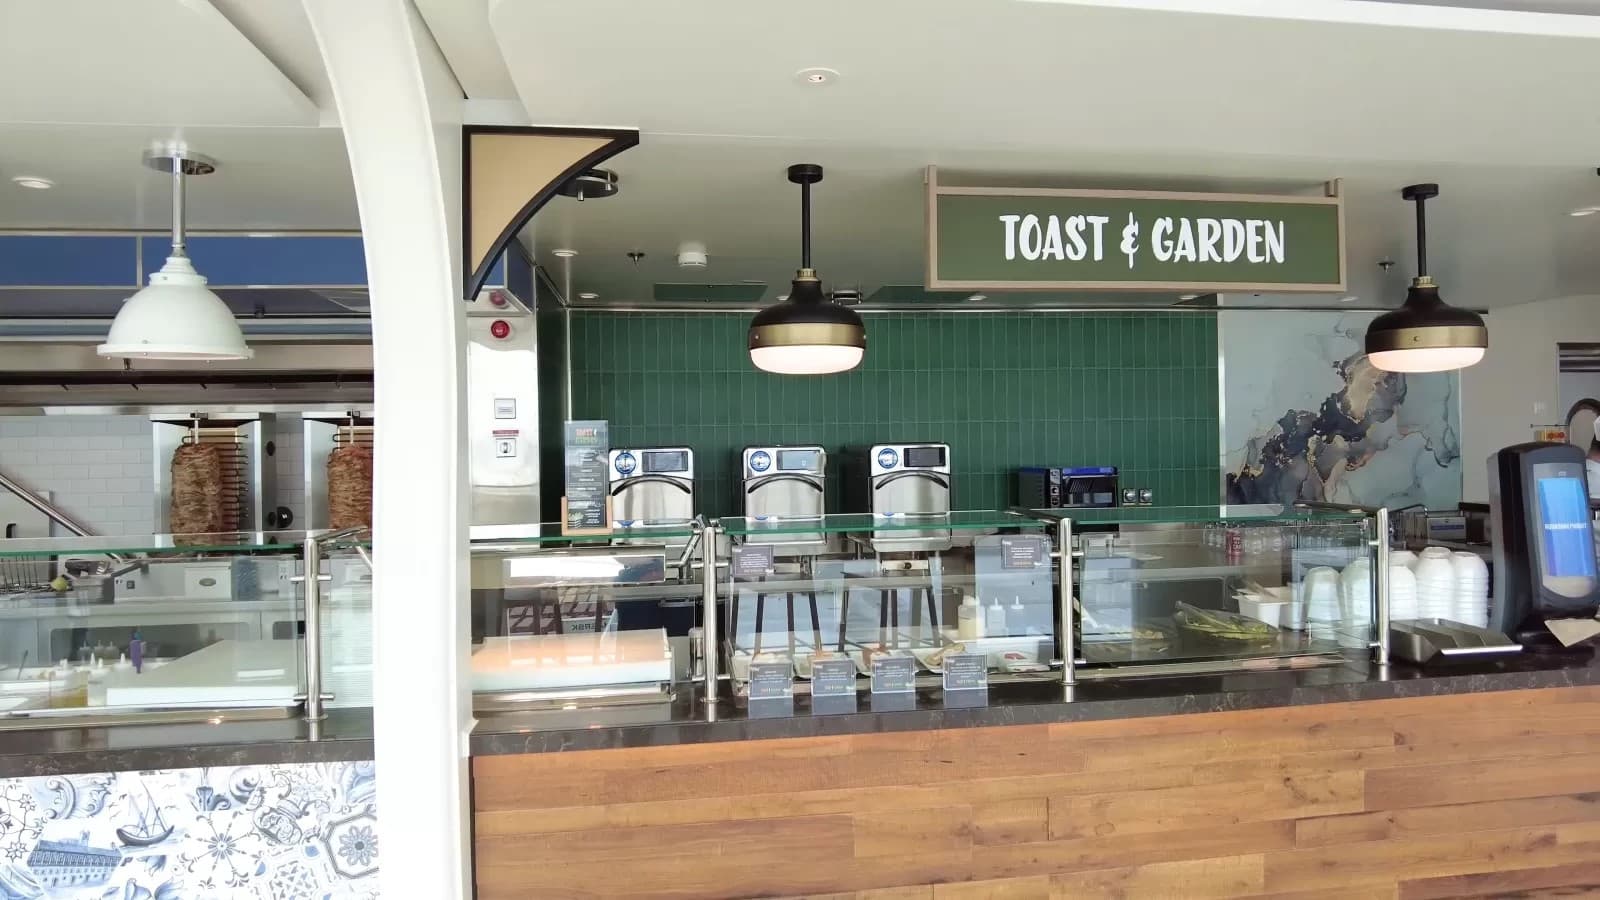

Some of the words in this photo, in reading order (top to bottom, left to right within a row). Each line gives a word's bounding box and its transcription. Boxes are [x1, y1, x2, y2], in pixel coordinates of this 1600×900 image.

[999, 214, 1109, 261] TOAST
[1120, 211, 1139, 269] &
[1151, 217, 1285, 264] GARDEN
